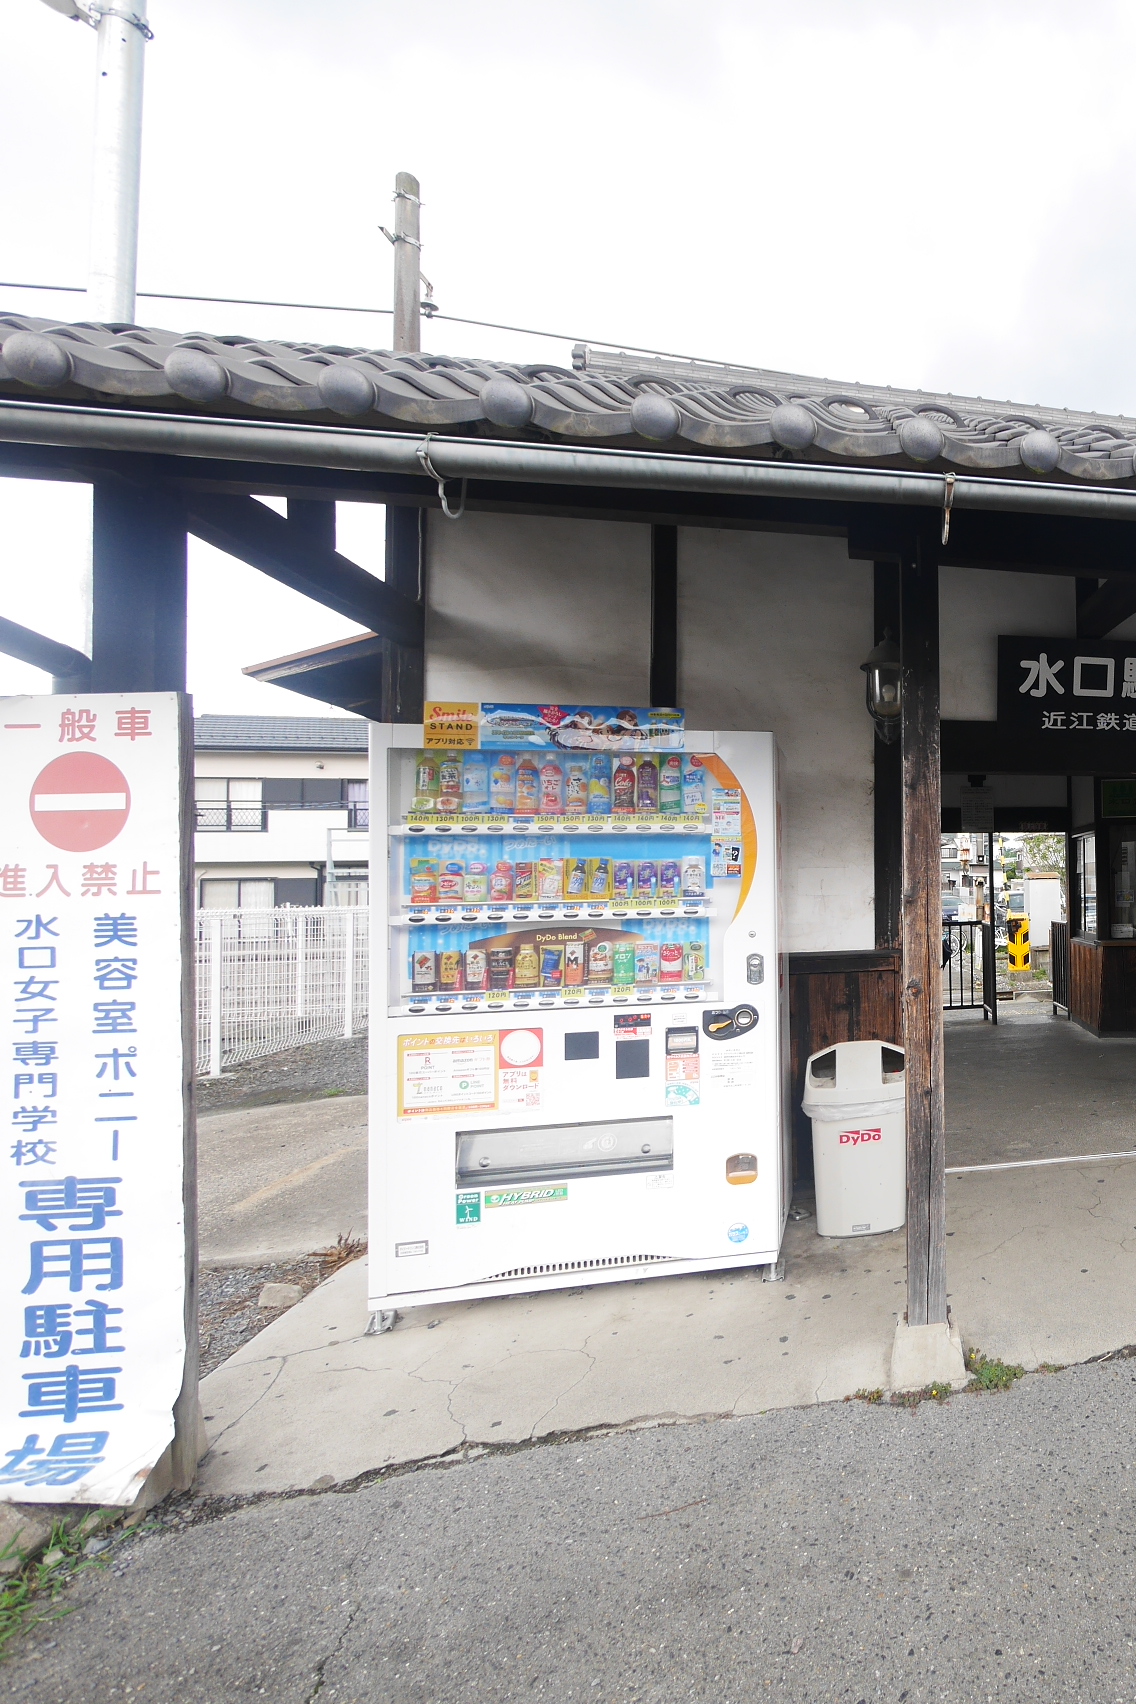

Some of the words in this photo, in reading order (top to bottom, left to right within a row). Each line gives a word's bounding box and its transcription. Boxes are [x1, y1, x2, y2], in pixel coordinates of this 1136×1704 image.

[4, 706, 153, 743] 一般車
[429, 723, 473, 731] STAND
[428, 839, 479, 855] DyDo
[0, 860, 162, 898] 進入禁止
[536, 934, 556, 942] DyDo
[558, 932, 577, 941] Blend
[10, 914, 60, 1166] 水口女子専門学校
[92, 912, 138, 1161] 美容室ポニー
[502, 1070, 527, 1078] アプリは
[503, 1083, 539, 1092] ダウンロード
[839, 1129, 881, 1146] DyDo
[500, 1189, 555, 1204] HYBRID
[0, 1175, 126, 1487] 専用駐車場
